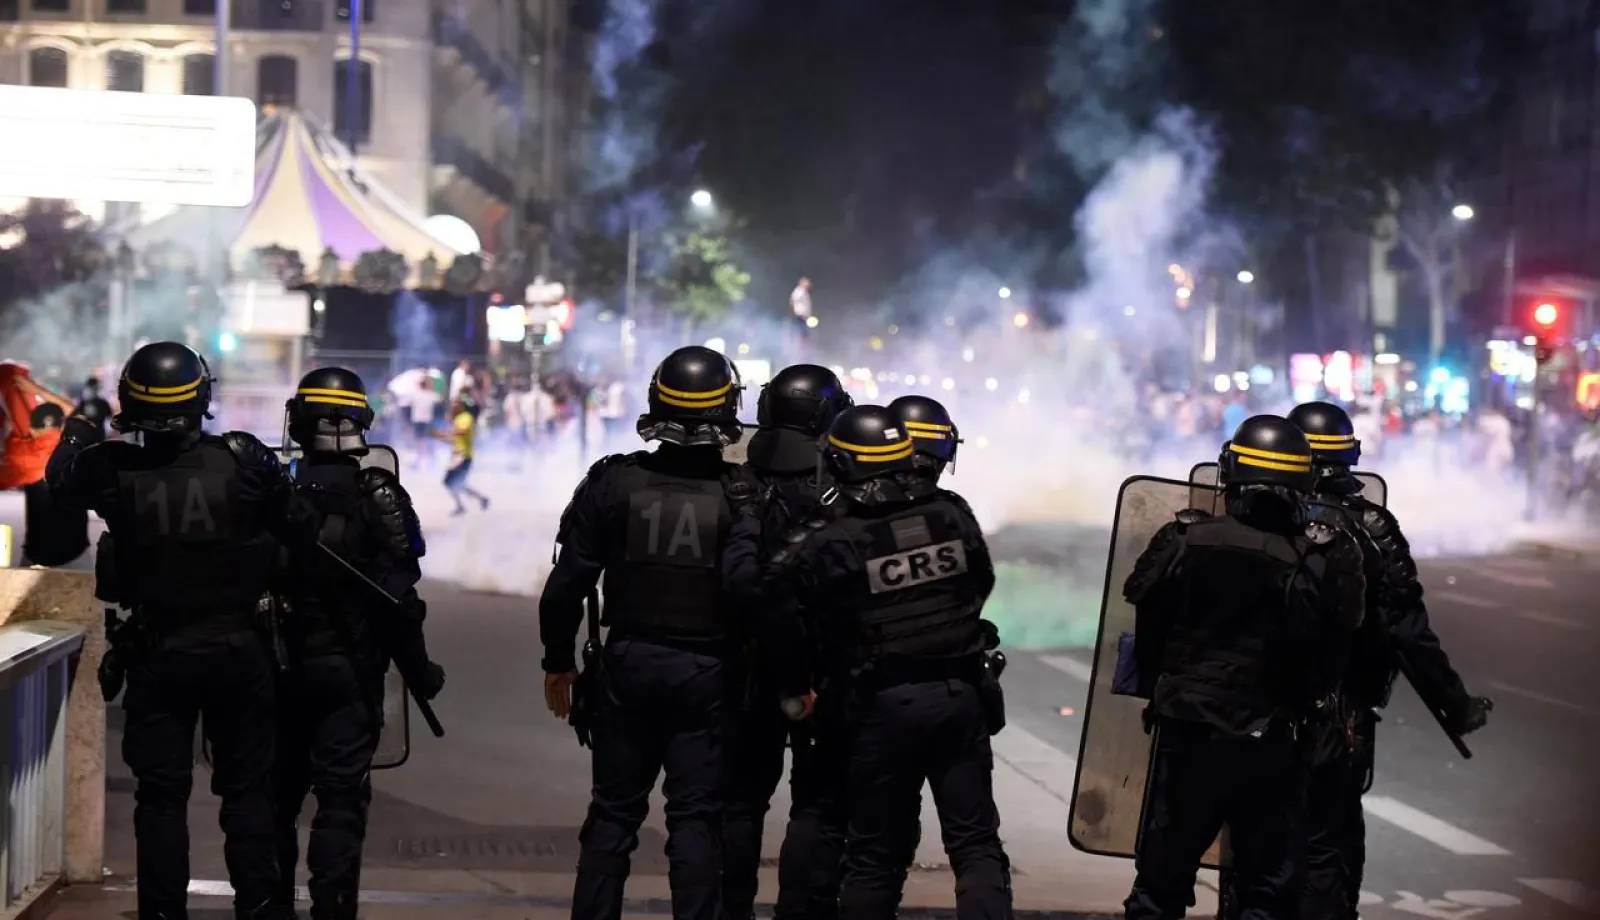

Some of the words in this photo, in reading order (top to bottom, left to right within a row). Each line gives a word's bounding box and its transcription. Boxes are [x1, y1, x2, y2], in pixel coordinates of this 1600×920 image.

[147, 477, 215, 535] 1A
[640, 500, 702, 559] 1A
[880, 546, 958, 586] CRS
